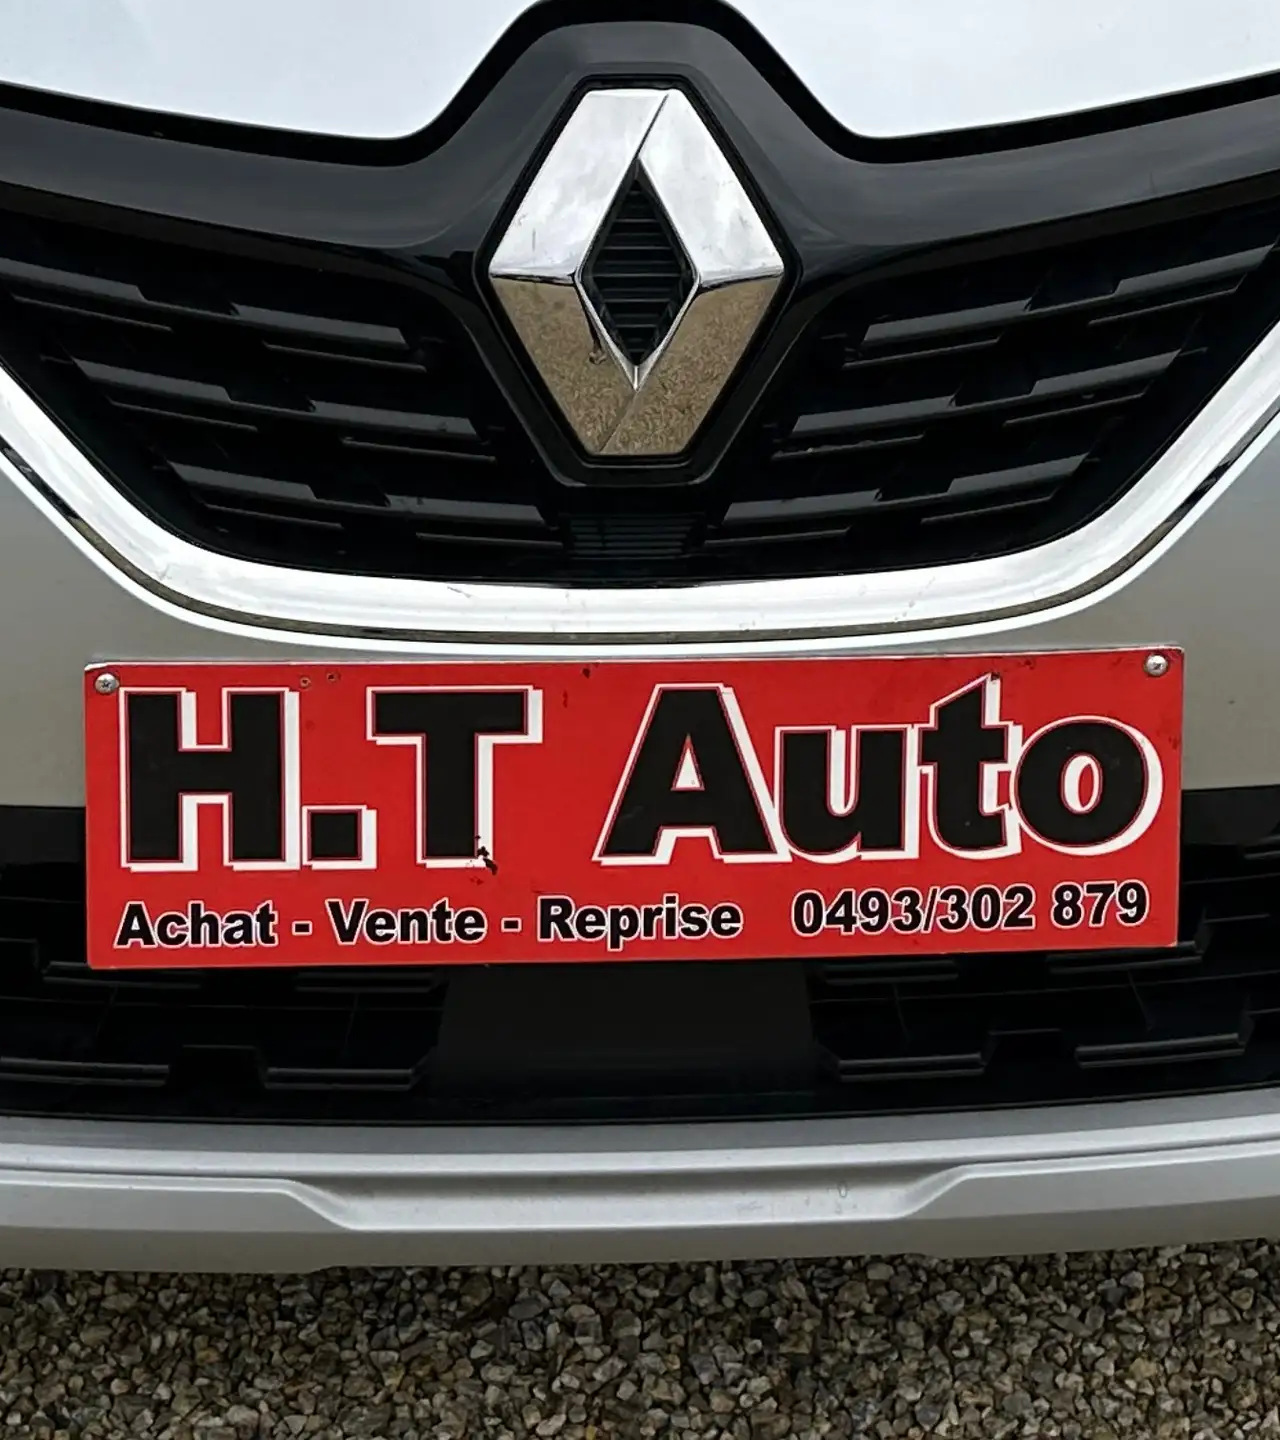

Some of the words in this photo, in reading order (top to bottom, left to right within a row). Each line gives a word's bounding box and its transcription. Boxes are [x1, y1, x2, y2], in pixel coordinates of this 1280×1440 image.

[120, 685, 543, 871] H.T
[592, 671, 1163, 864] Auto
[115, 899, 279, 948] Achat
[291, 918, 313, 936] -
[325, 897, 487, 945] Vente
[500, 915, 522, 933] -
[536, 893, 743, 952] Reprise
[791, 884, 1036, 936] 0493/302
[1050, 879, 1149, 928] 879
